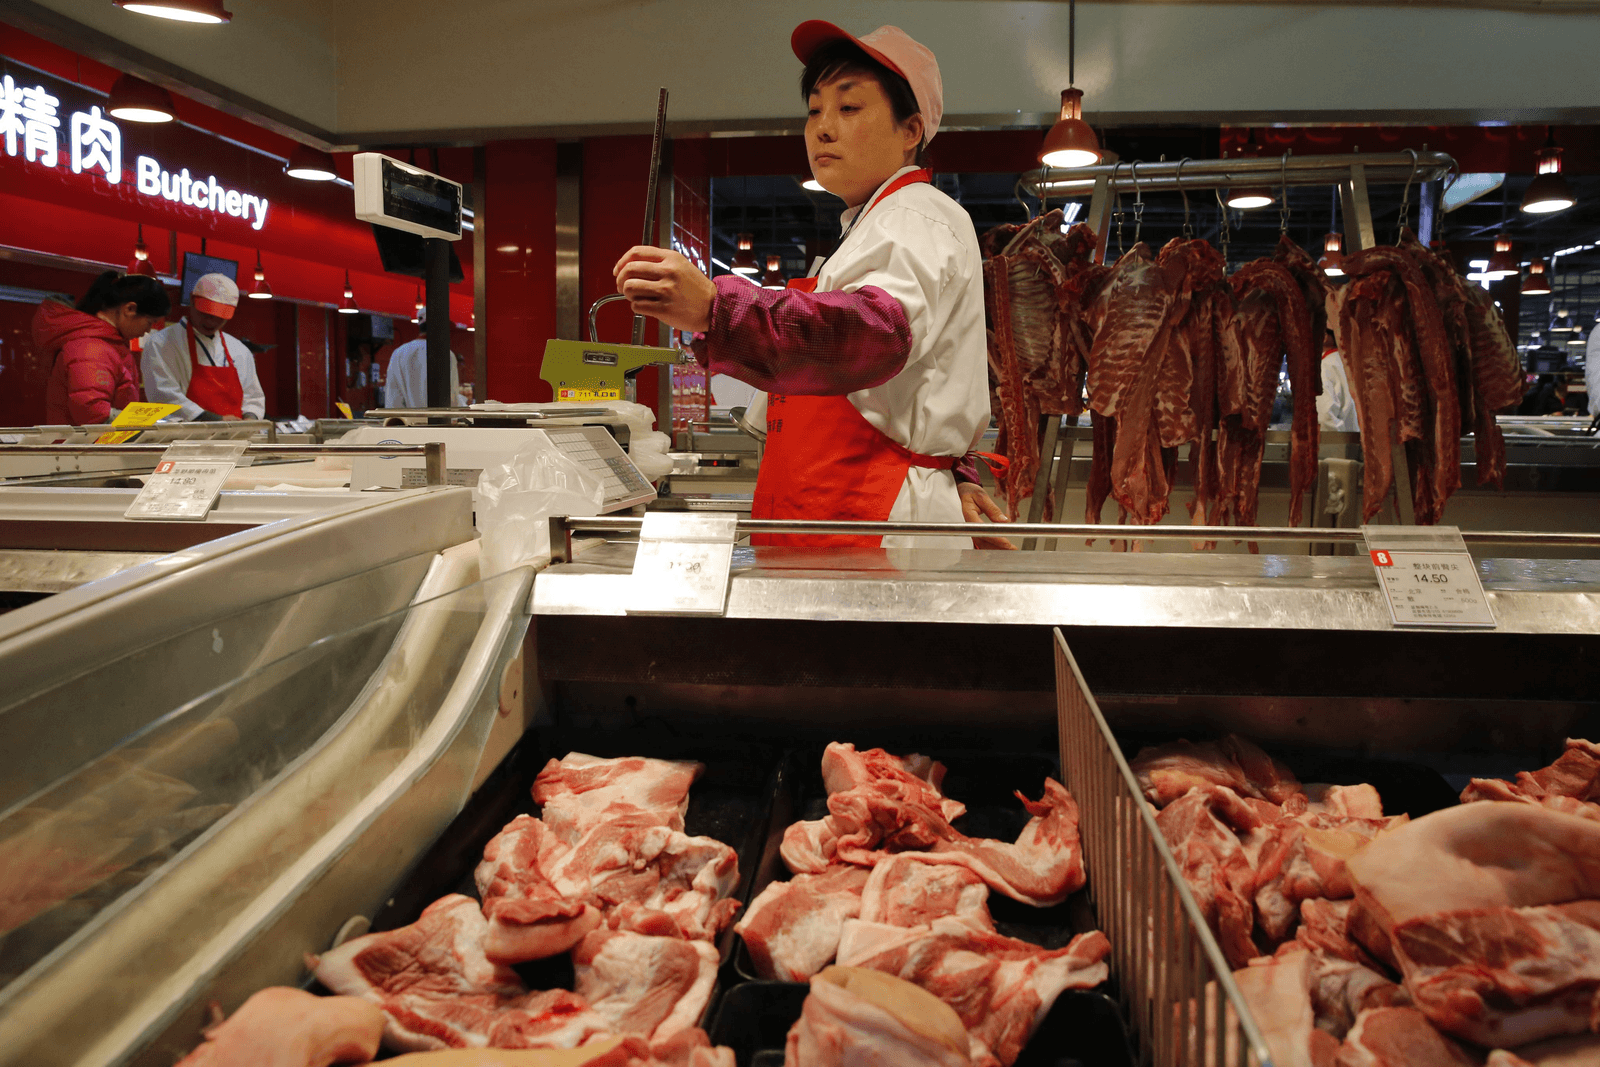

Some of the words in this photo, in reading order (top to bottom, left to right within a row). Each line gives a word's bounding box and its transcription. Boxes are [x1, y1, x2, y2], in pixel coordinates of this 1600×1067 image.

[0, 74, 121, 184] 精肉
[136, 155, 269, 230] Butchery
[161, 463, 172, 472] 6
[1376, 552, 1388, 564] 8
[1413, 574, 1448, 583] 14.50
